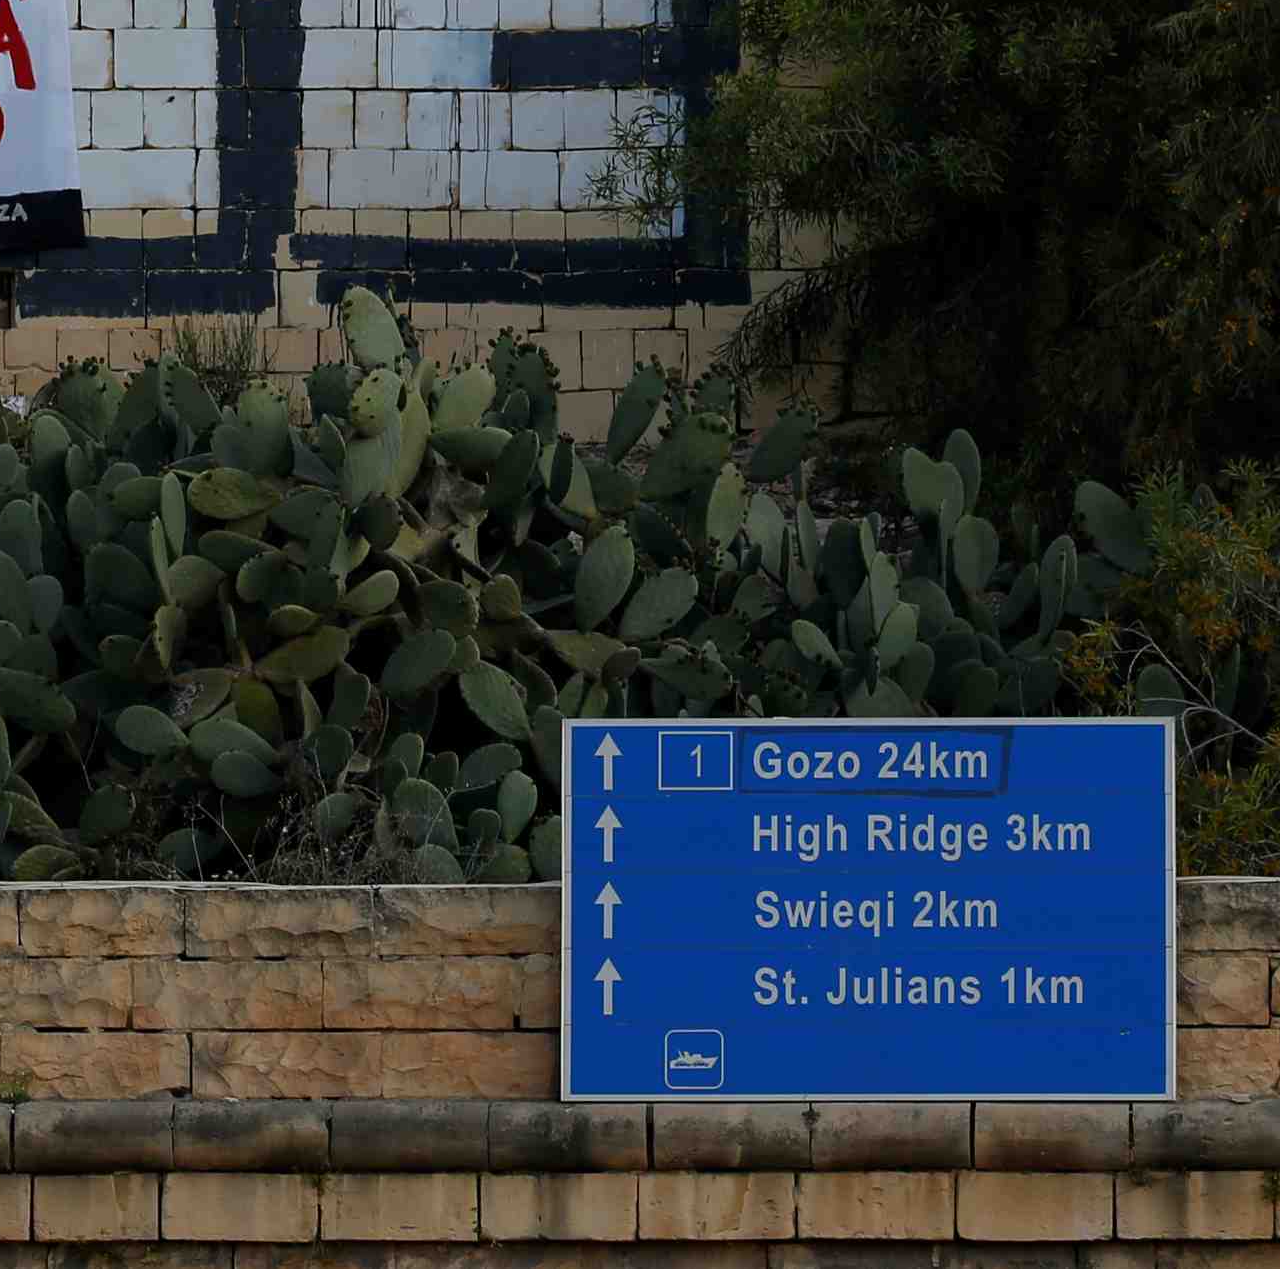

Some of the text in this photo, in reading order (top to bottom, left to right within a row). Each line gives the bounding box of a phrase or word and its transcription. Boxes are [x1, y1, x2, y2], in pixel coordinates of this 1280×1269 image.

[688, 741, 988, 780] 1 Gozo 24km
[753, 814, 1091, 862] High Ridge 3km
[754, 890, 998, 936] Swieqi 2km
[754, 967, 1084, 1005] St. Julians 1km
